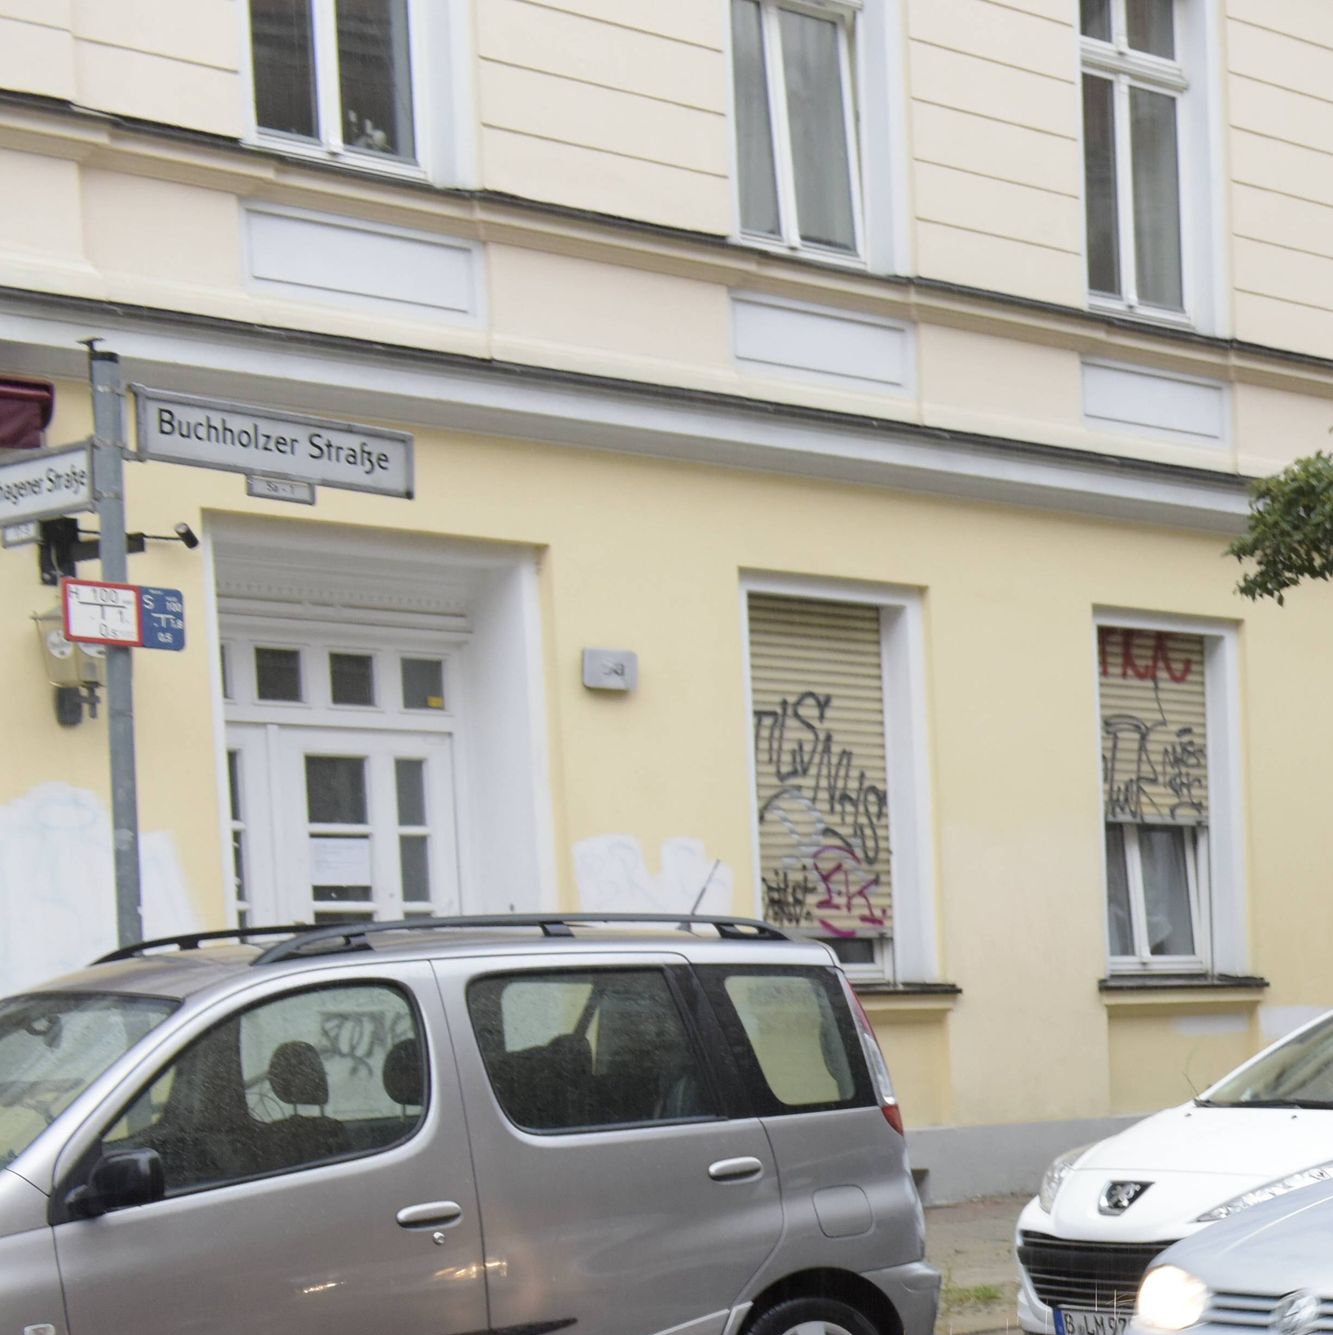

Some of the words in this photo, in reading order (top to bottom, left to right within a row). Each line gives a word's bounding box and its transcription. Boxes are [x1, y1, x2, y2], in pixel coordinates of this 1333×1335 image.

[158, 407, 298, 455] Buchholzer
[308, 433, 390, 475] Straße
[46, 464, 87, 495] Straße
[142, 594, 155, 609] S
[1064, 1312, 1076, 1335] B
